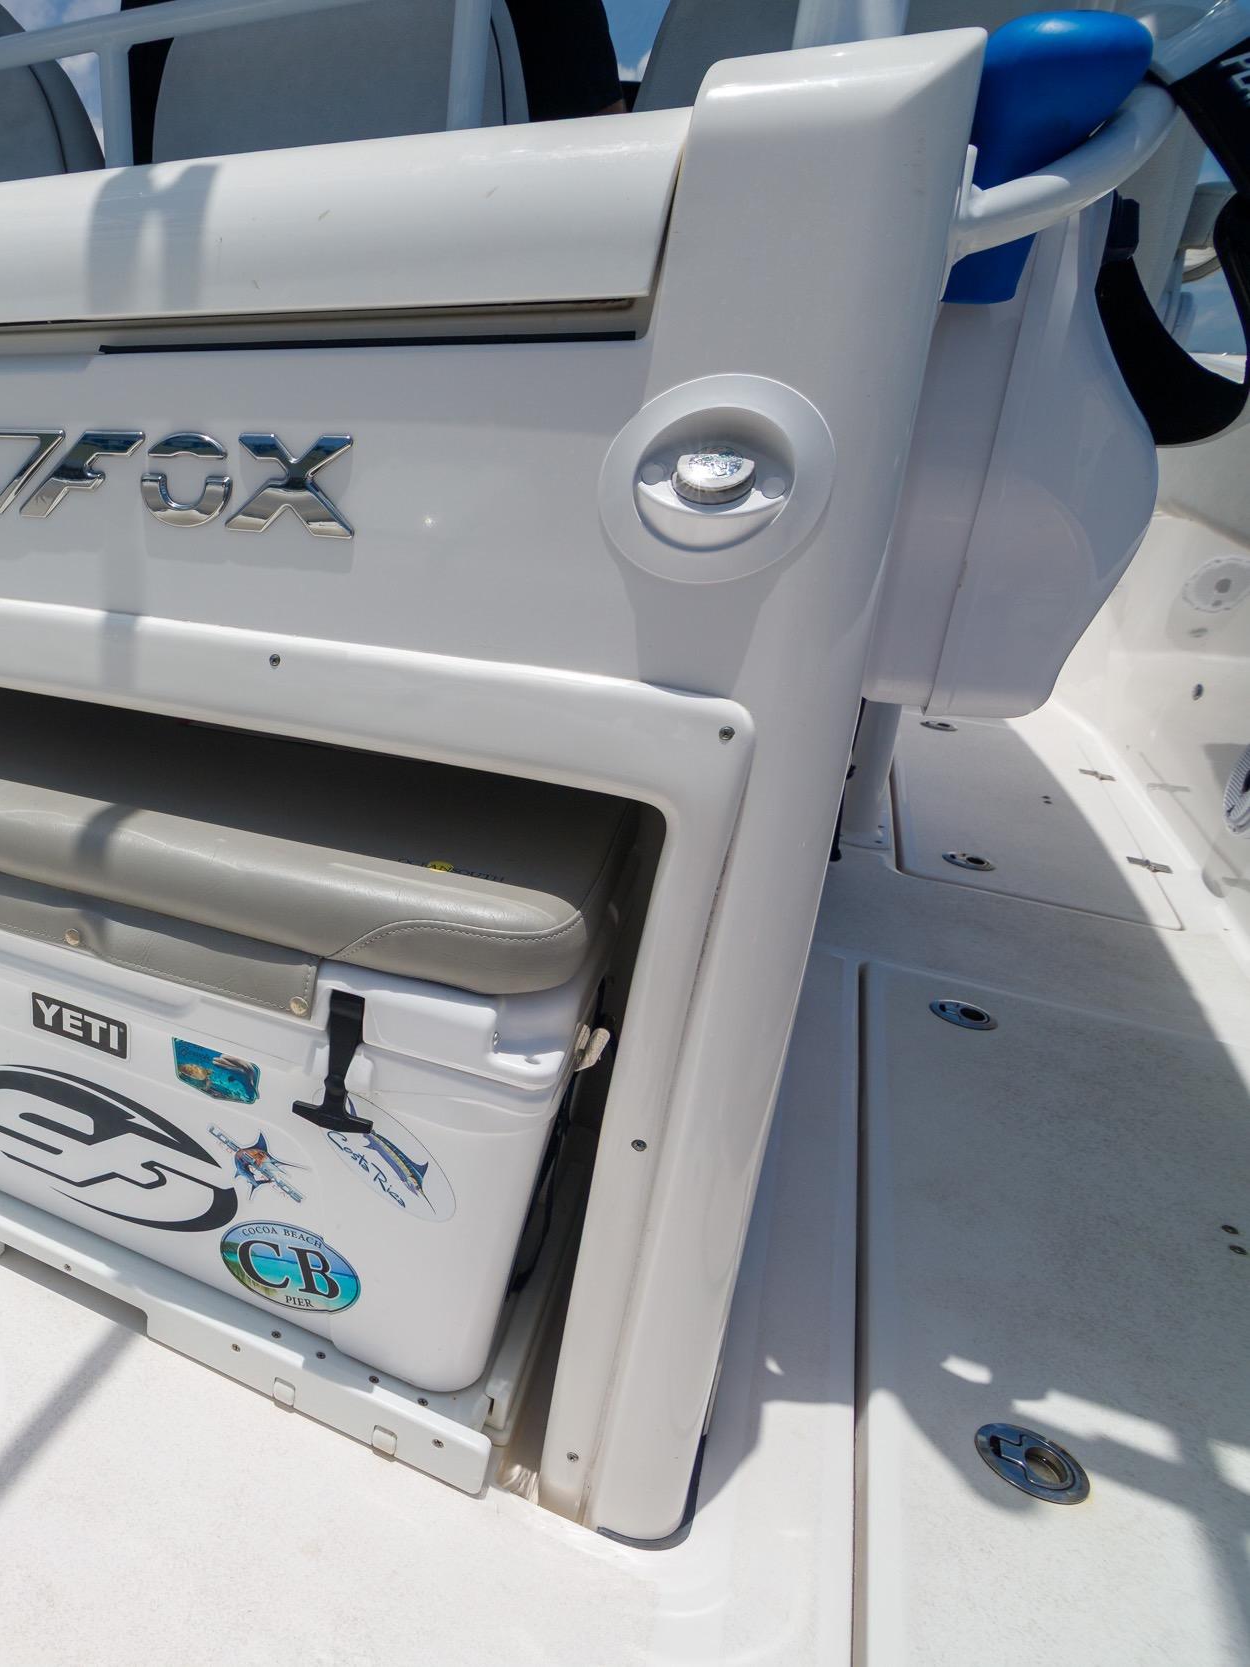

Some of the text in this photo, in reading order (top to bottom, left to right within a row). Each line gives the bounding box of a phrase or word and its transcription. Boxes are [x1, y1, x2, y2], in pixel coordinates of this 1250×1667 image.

[35, 998, 119, 1050] YETI
[327, 1130, 406, 1209] Costa Rica
[241, 1225, 323, 1250] COCOA BEACH
[238, 1240, 340, 1299] CB
[285, 1295, 315, 1308] PIER
